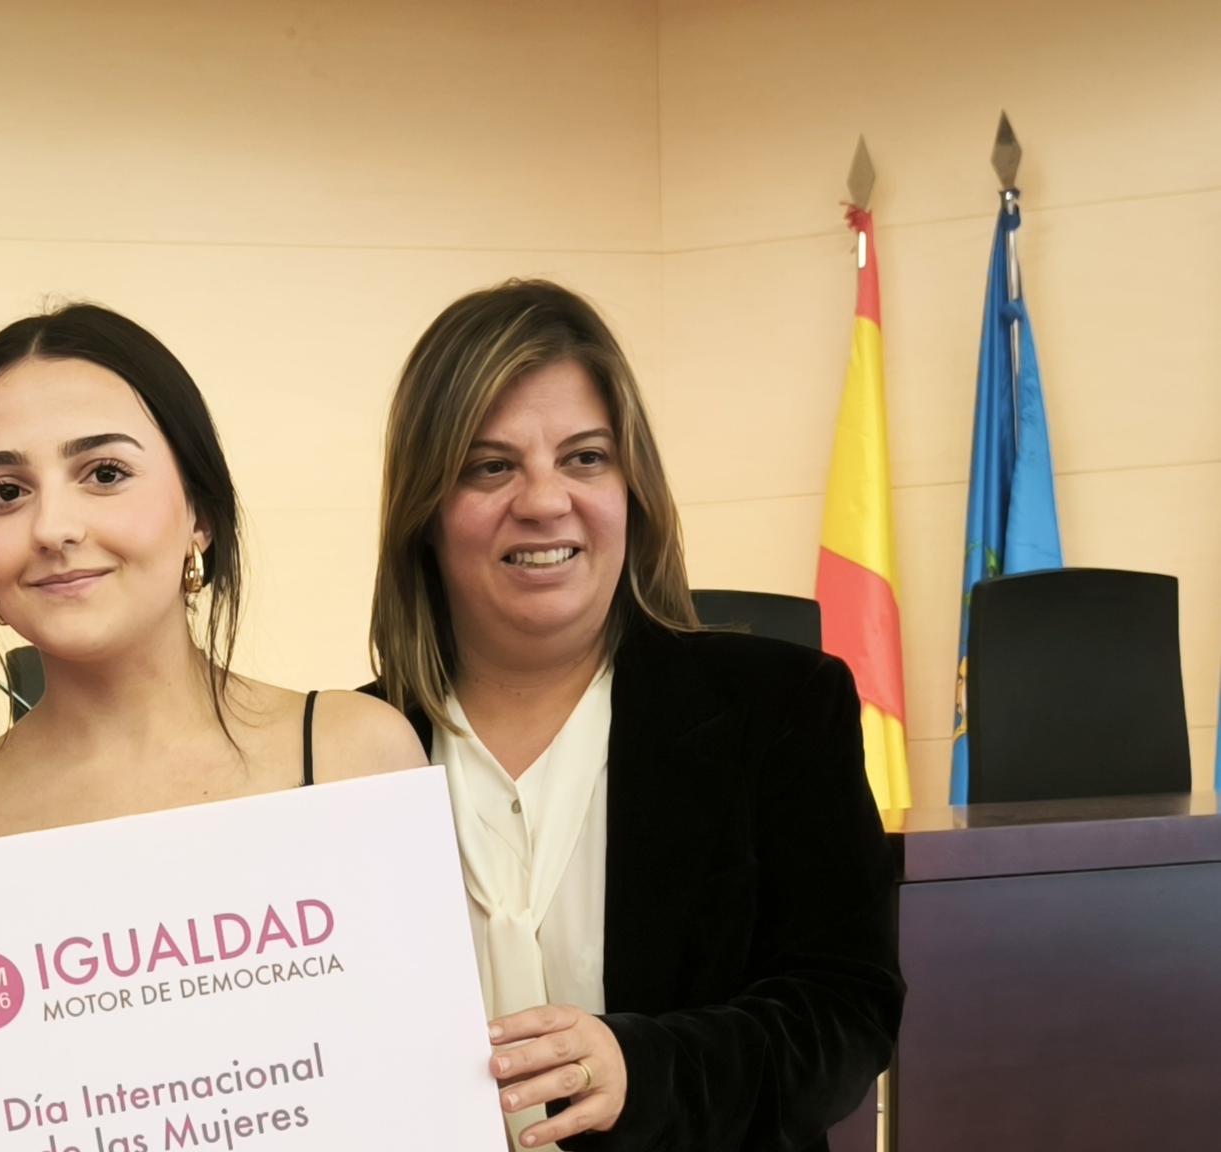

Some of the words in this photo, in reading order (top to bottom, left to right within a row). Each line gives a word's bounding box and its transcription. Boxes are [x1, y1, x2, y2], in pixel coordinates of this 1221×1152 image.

[35, 898, 335, 990] IGUALDAD
[43, 989, 134, 1021] MOTOR
[142, 982, 172, 1006] DE
[180, 953, 345, 999] DEMOCRACIA
[3, 1093, 69, 1131] Día
[81, 1042, 325, 1118] Internacional
[163, 1104, 309, 1151] Mujeres
